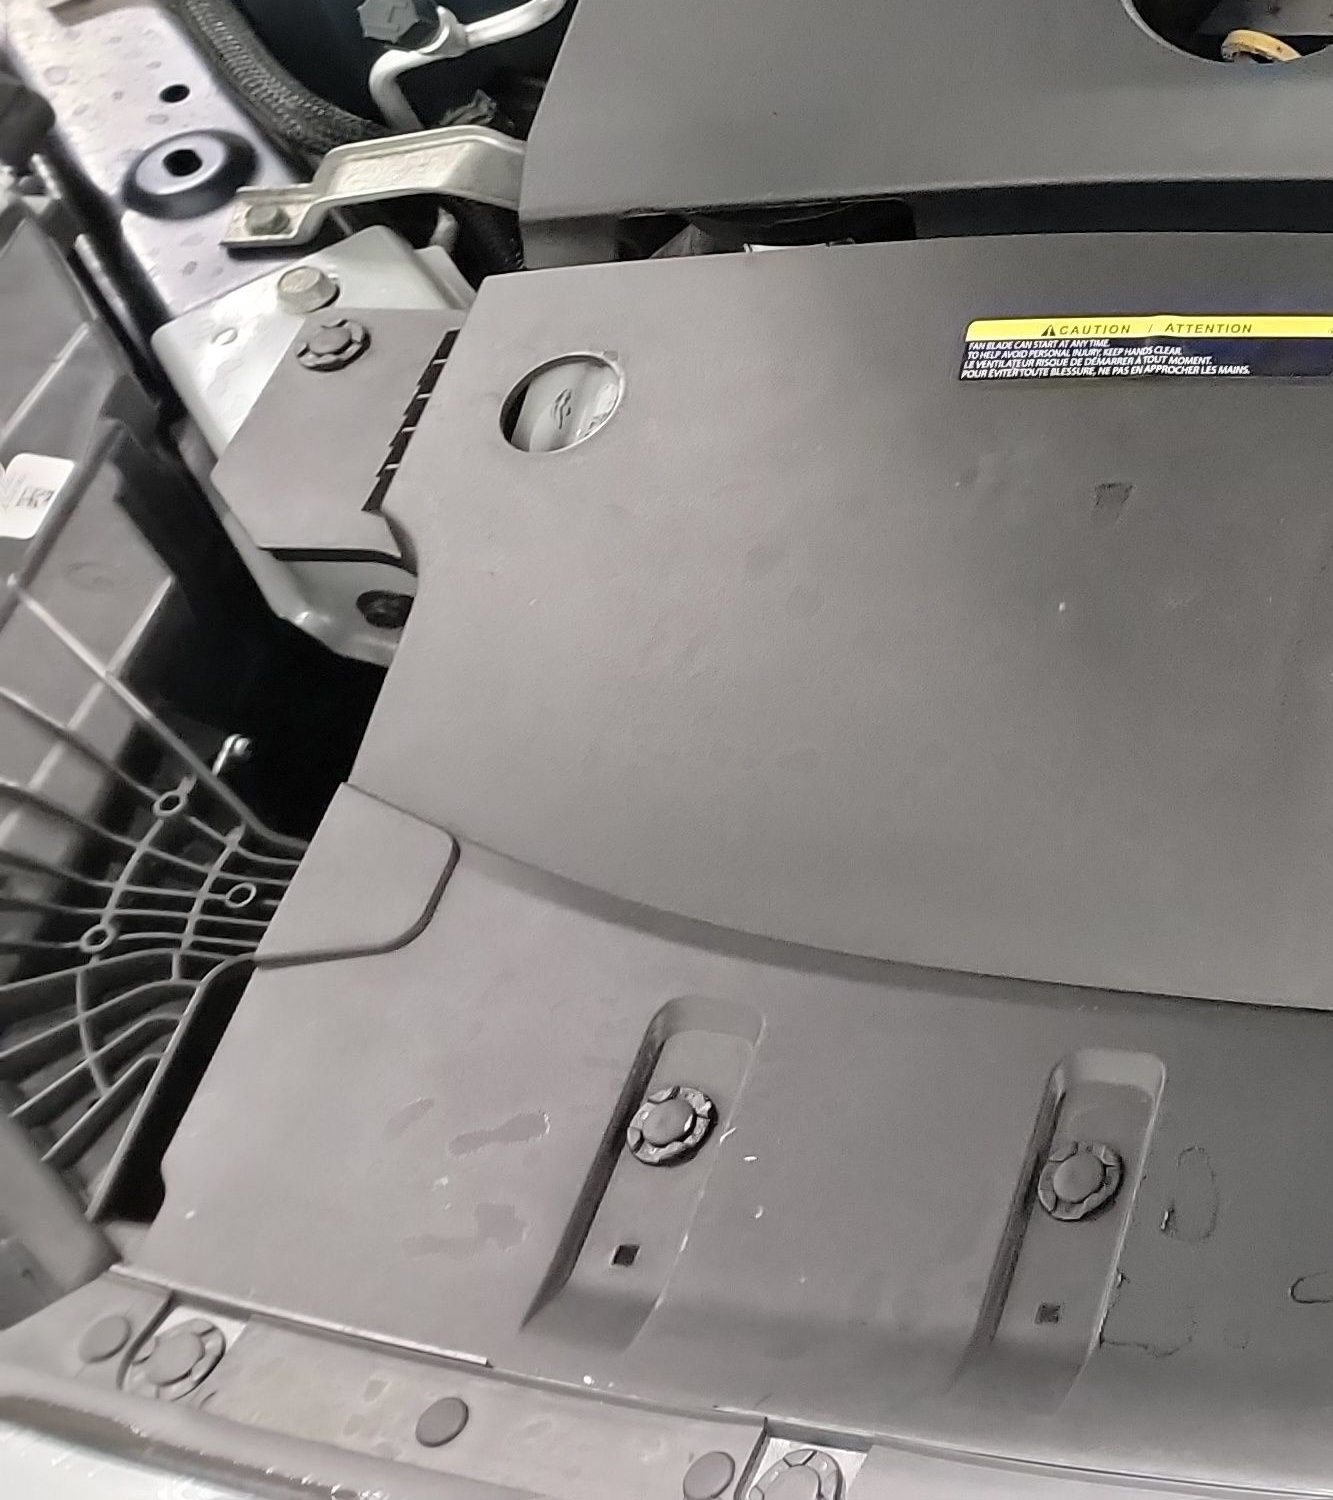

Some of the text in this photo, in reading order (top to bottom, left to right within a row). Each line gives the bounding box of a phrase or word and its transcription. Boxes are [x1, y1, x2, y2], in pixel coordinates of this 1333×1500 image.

[1060, 325, 1130, 335] CAUTION
[1164, 323, 1252, 334] ATTENTION
[968, 341, 985, 350] FAN
[1014, 341, 1033, 350] CAN
[1034, 340, 1057, 349] START
[1058, 340, 1069, 348] AT
[1070, 340, 1088, 348] ANY
[967, 351, 979, 360] TO
[980, 350, 1001, 359] HELP
[1001, 349, 1027, 359] AVOID
[1028, 348, 1071, 358] PERSONAL
[1103, 347, 1124, 357] KEEP
[1125, 346, 1153, 356] HANDS
[964, 360, 975, 369] LE
[976, 359, 1033, 369] VENTILATEUR
[1035, 357, 1069, 368] RISQUE
[1070, 357, 1083, 366] DE
[1084, 355, 1134, 366] DÉMARRER
[1143, 355, 1168, 364] TOUT
[1168, 356, 1213, 365] MOMENT.
[961, 369, 987, 379] POUR
[1020, 367, 1049, 377] TOUTE
[1050, 367, 1097, 377] BLESSURE,
[1098, 366, 1111, 376] NE
[1112, 366, 1130, 376] PAS
[1131, 365, 1144, 375] EN
[1143, 364, 1199, 375] APPROCHER
[1201, 365, 1217, 375] LES
